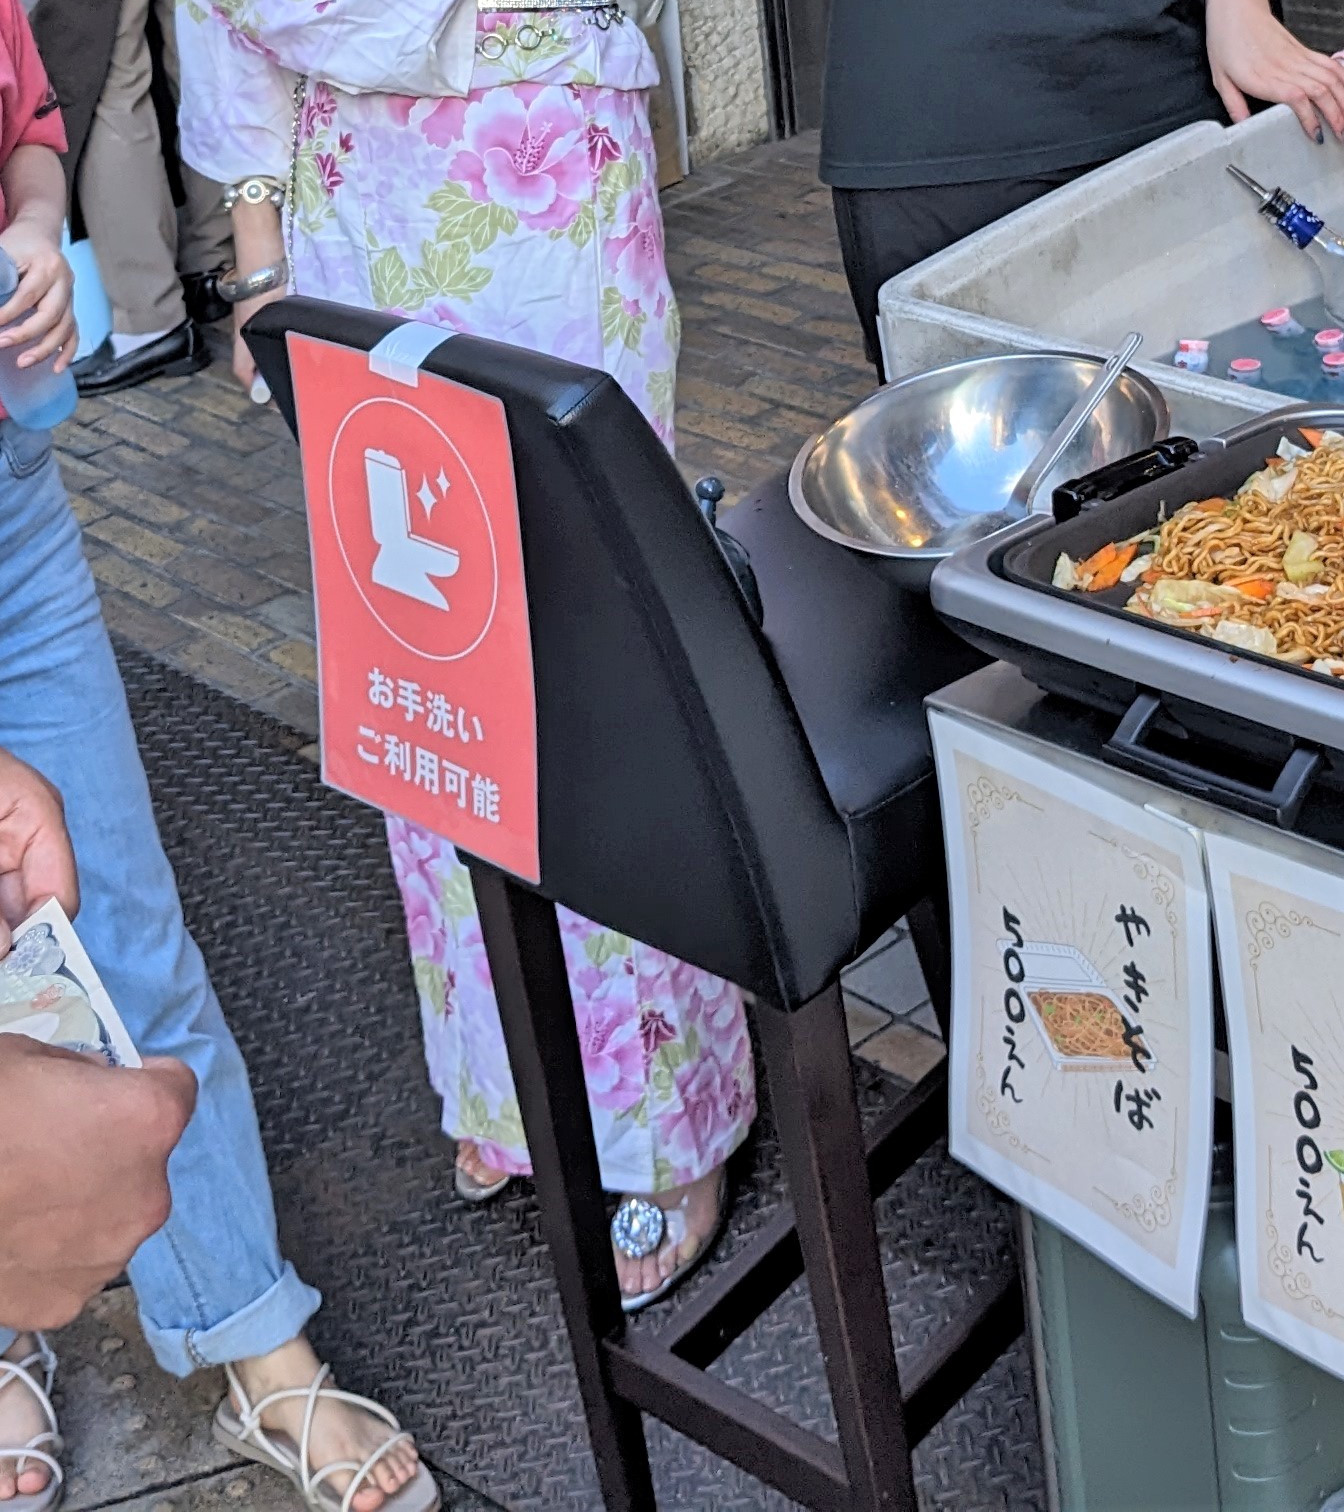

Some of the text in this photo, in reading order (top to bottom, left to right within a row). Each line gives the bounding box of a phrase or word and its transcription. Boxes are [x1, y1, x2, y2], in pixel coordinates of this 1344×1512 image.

[367, 667, 485, 744] お手洗い
[356, 726, 502, 825] ご利用可能
